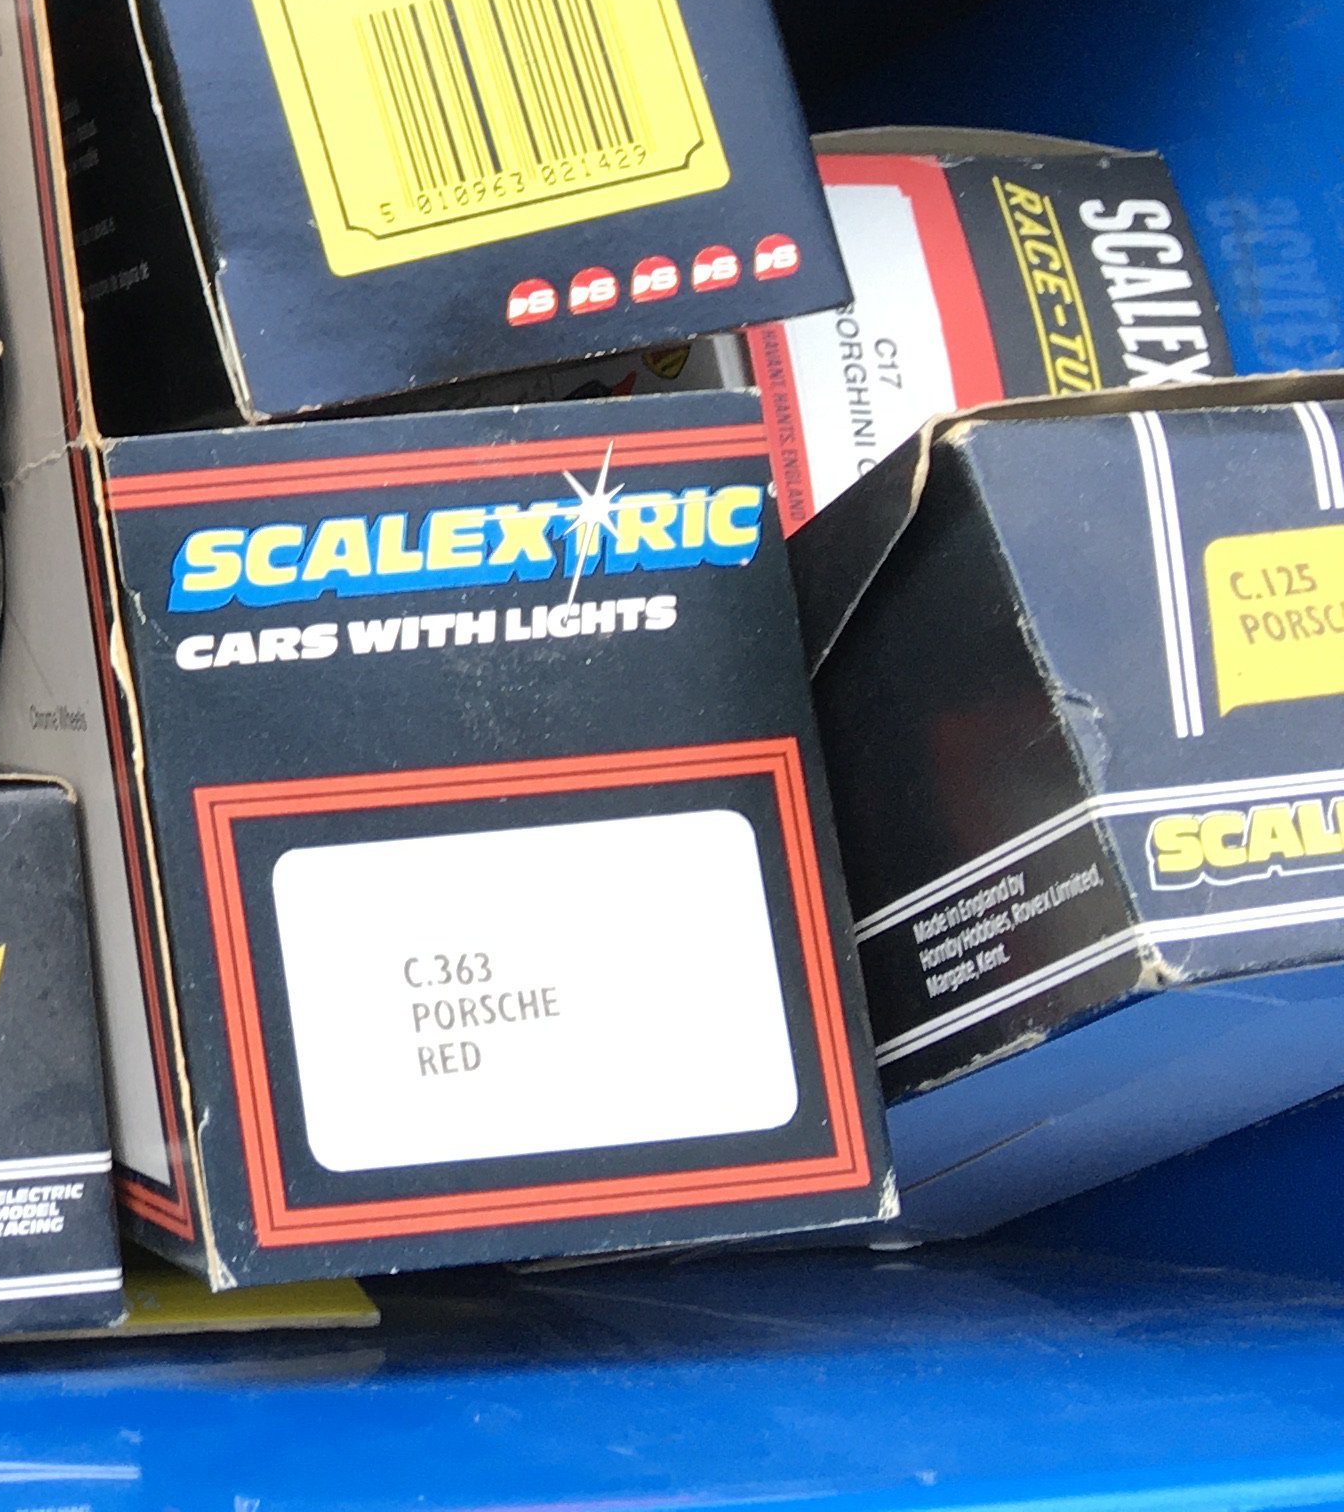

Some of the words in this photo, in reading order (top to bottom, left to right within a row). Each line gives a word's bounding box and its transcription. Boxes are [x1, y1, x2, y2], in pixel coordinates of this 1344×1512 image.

[417, 171, 528, 215] 010963
[541, 145, 649, 187] 021429
[167, 485, 766, 612] SCALEXTRIC
[1231, 563, 1319, 601] C.125
[174, 629, 339, 672] CARS
[347, 609, 497, 655] WITH
[505, 595, 678, 641] LIGHTS
[913, 913, 947, 944] Made
[959, 875, 1008, 921] England
[919, 929, 963, 971] Hornby
[1011, 893, 1052, 925] Rovex
[402, 951, 494, 989] C.363
[411, 986, 561, 1033] PORSCHE
[418, 1040, 482, 1078] RED
